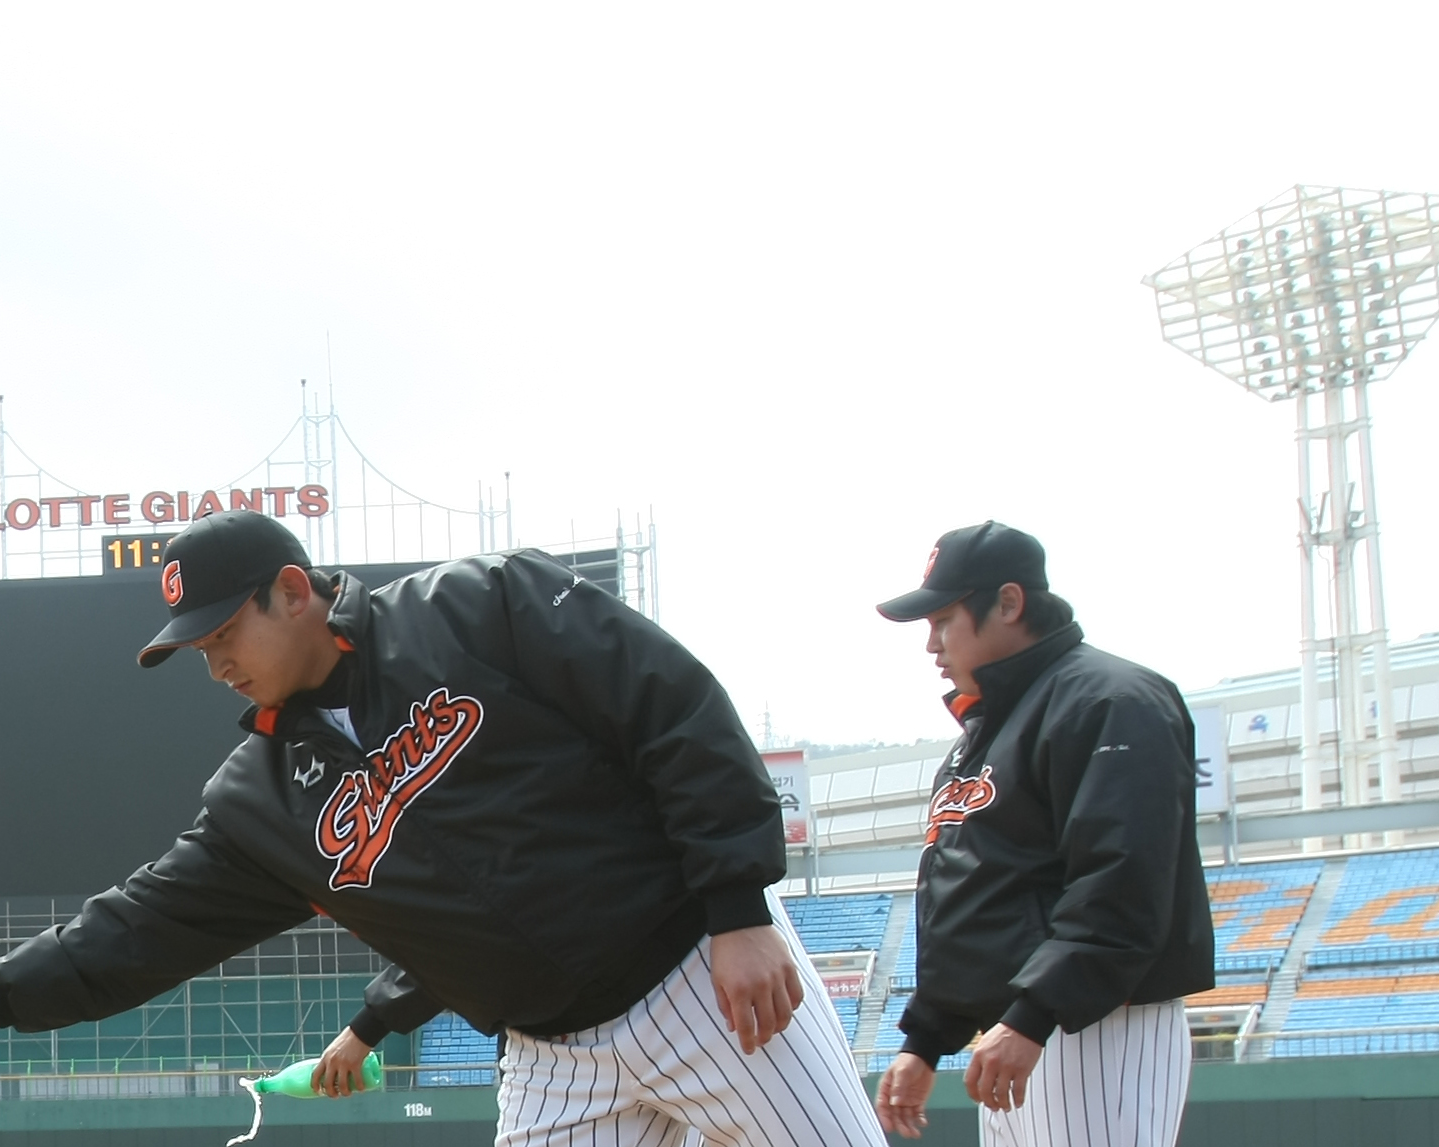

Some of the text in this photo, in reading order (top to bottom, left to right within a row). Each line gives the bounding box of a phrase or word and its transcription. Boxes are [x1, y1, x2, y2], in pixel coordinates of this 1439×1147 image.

[141, 484, 329, 524] GIANTS
[108, 539, 168, 568] 11:
[315, 687, 484, 892] Giants
